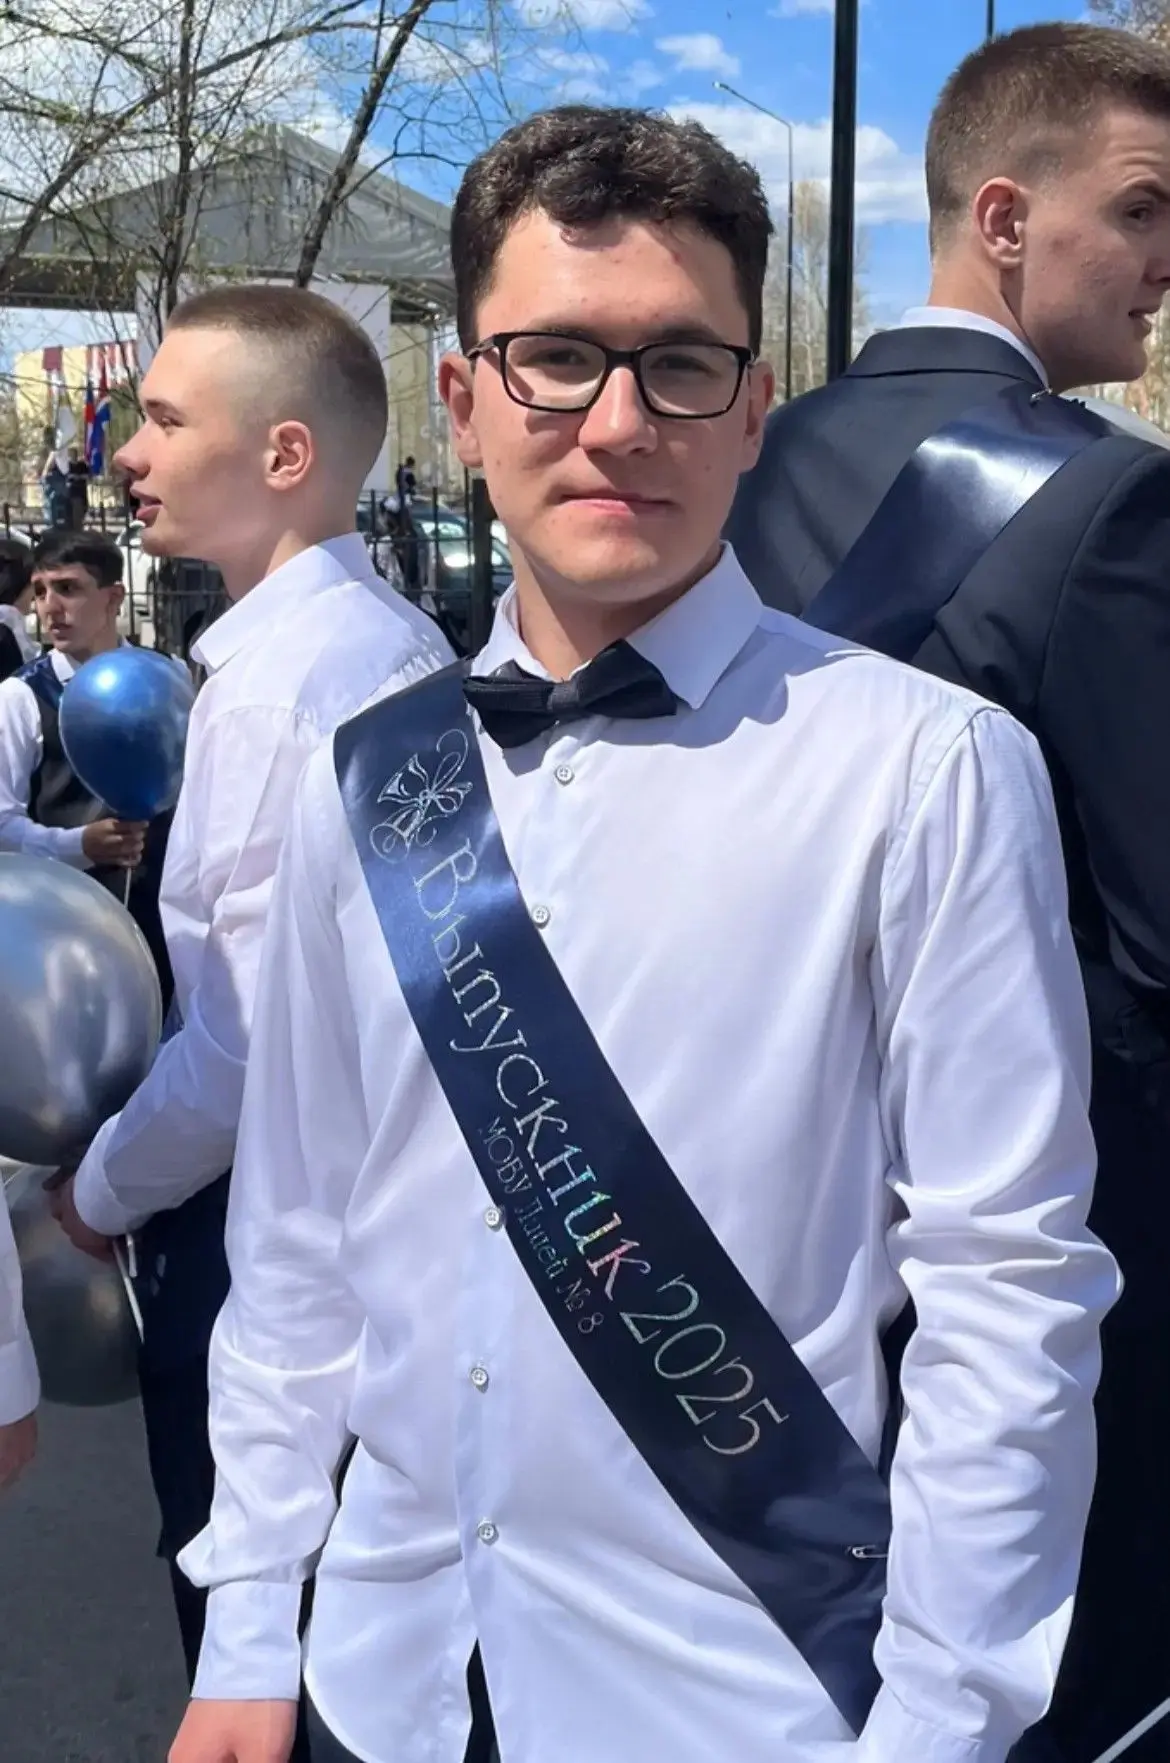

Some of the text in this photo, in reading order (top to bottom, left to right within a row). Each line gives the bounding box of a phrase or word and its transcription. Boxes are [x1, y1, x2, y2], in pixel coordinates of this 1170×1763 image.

[413, 838, 789, 1455] Выпускник 2025
[477, 1116, 532, 1194] МОБУ
[514, 1196, 568, 1279] Лицей
[577, 1311, 604, 1334] 8
